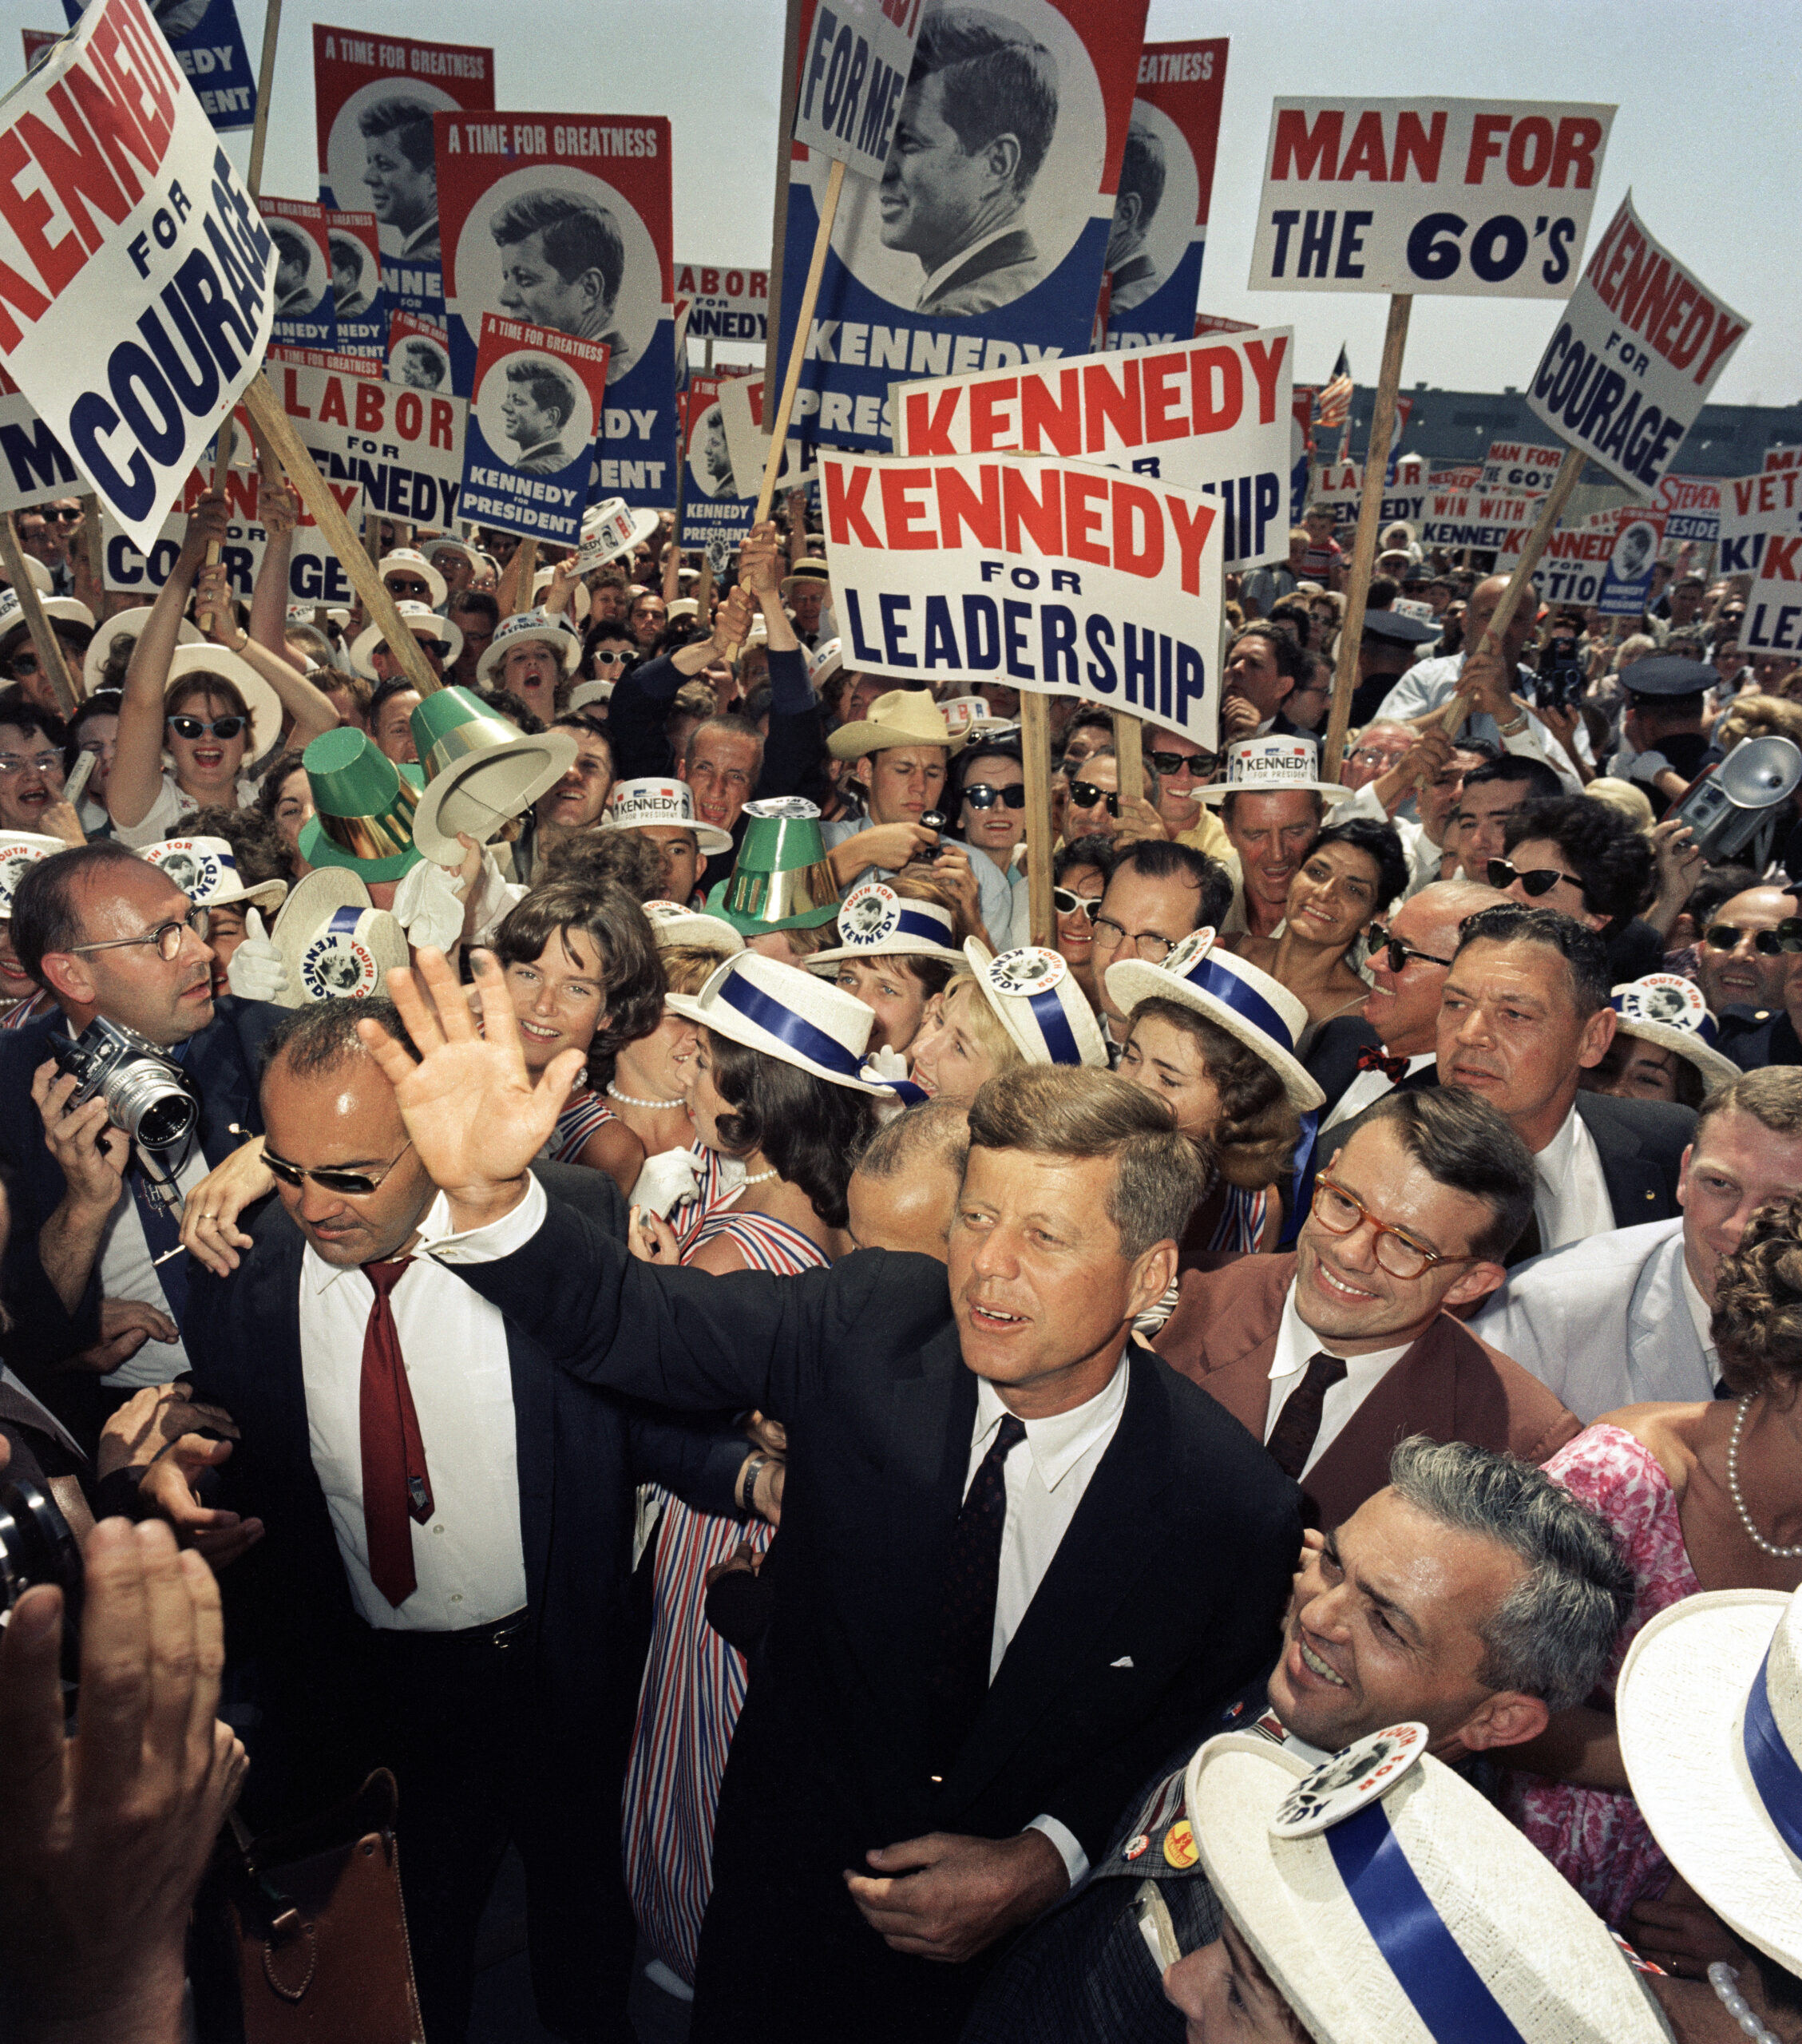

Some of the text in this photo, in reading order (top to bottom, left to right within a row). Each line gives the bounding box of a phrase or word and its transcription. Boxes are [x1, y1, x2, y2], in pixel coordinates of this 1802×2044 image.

[325, 36, 485, 79] A TIME FOR GREATNESS
[803, 6, 905, 162] FOR ME
[449, 125, 657, 157] A TIME FOR GREATNESS
[1271, 109, 1602, 188] MAN FOR
[126, 178, 192, 280] FOR
[1271, 209, 1575, 284] THE 60'S
[401, 298, 422, 308] FOR
[695, 296, 728, 308] FOR
[1586, 198, 1746, 386] KENNEDY
[69, 145, 273, 523] COURAGE
[488, 318, 604, 362] A TIME FOR GREATNESS
[327, 356, 378, 375] GREATNESS
[1604, 331, 1650, 377] FOR
[284, 368, 453, 452] LABOR
[906, 336, 1288, 458] KENNEDY
[1535, 323, 1685, 487] COURAGE
[598, 409, 658, 440] DY
[347, 436, 399, 459] FOR
[1488, 444, 1561, 468] MAN FOR
[469, 465, 578, 507] KENNEDY
[1322, 463, 1420, 491] LAR
[463, 493, 577, 536] PRESIDENT
[513, 496, 529, 505] FOR
[687, 503, 750, 520] KENNEDY
[1434, 496, 1527, 521] WIN WITH
[824, 461, 1217, 597] KENNEDY
[107, 535, 352, 602] CORGE
[980, 561, 1082, 596] FOR
[1548, 561, 1584, 570] FOR
[845, 588, 1205, 727] LEADERSHIP
[1246, 757, 1309, 771] KENNEDY
[1271, 770, 1308, 778] PRESIDENT
[620, 798, 679, 814] KENNEDY
[640, 810, 678, 819] PRESIDENT
[166, 842, 192, 850] FOR
[843, 886, 894, 913] YOUTH FOR
[842, 911, 897, 945] KENNEDY
[303, 936, 338, 1000] KENNEDY
[351, 941, 374, 978] YOUTH
[990, 949, 1024, 991] KENNEDY
[1037, 949, 1062, 988] YOUTH FOR
[1642, 976, 1701, 1009] YOUTH FOR
[1358, 1726, 1418, 1791] YOUTH FOR
